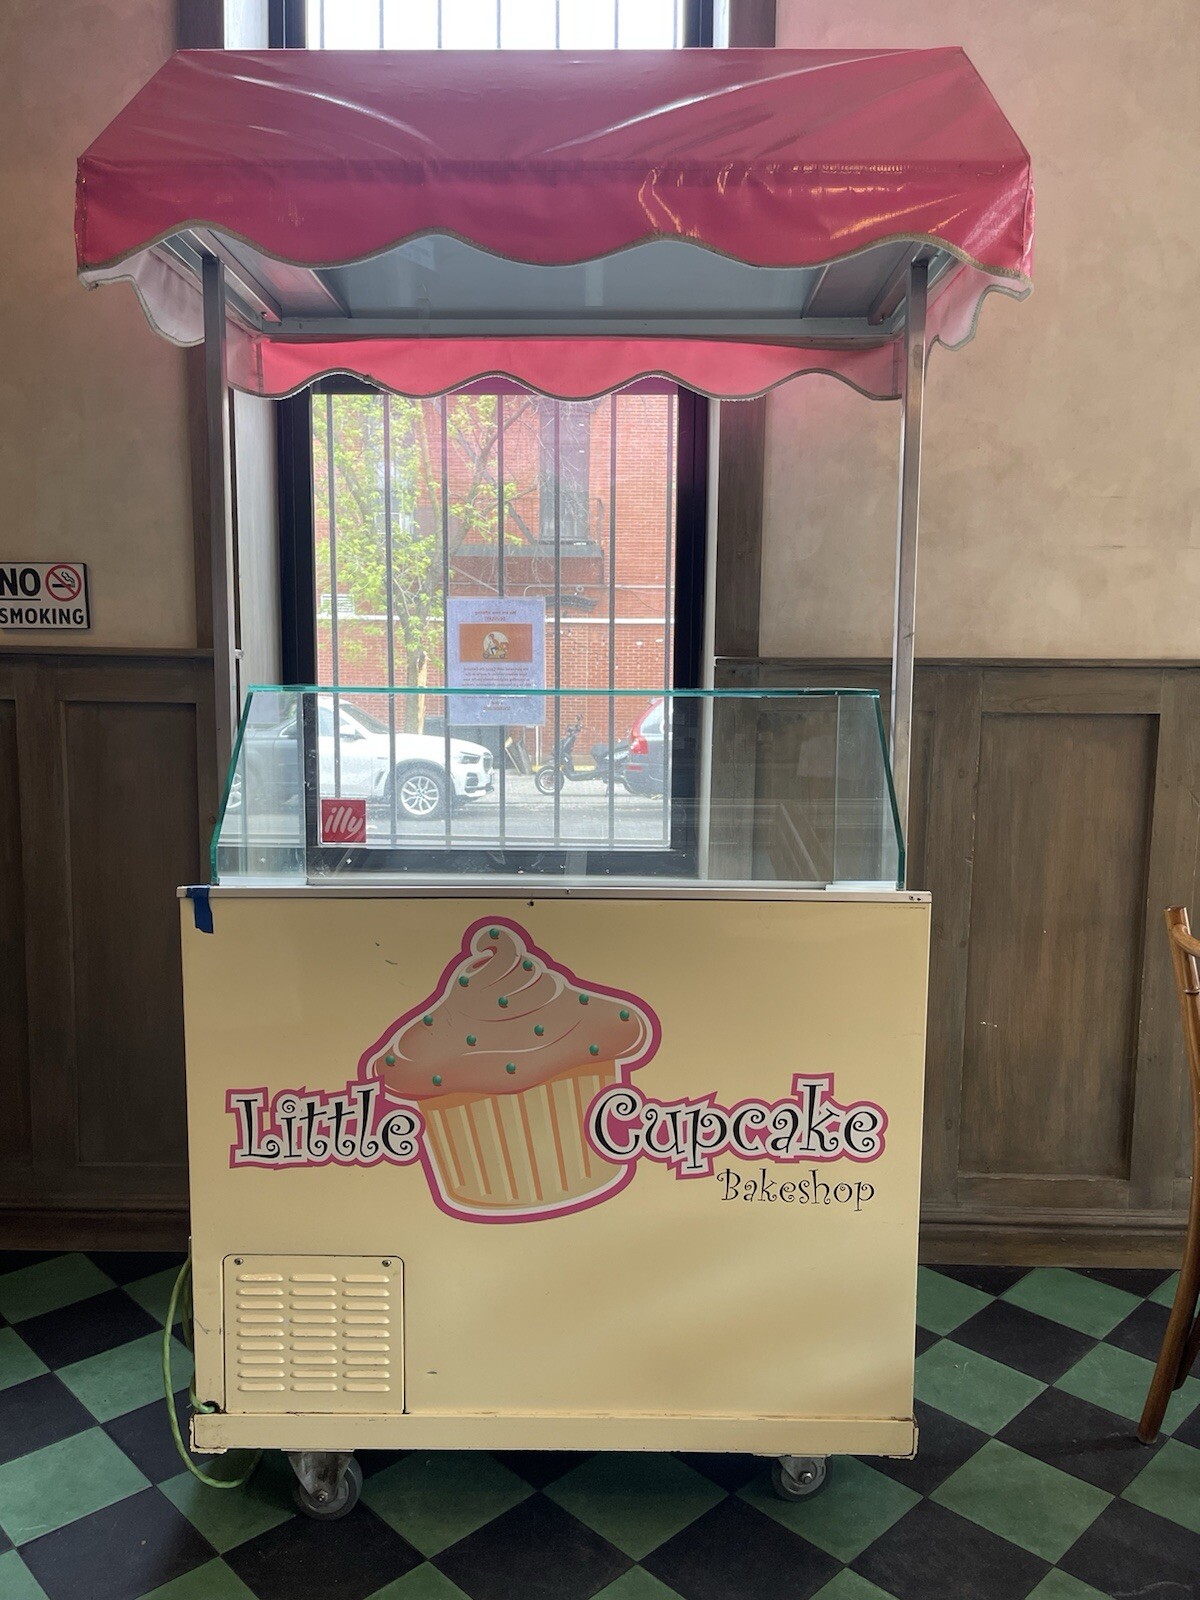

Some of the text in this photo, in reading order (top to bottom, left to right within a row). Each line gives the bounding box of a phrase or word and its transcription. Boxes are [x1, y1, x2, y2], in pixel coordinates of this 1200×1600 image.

[0, 568, 40, 596] NO
[0, 608, 84, 624] SMOKING
[324, 806, 364, 840] illy
[235, 1083, 879, 1169] Little Cupcake
[716, 1168, 875, 1212] Bakeshop
